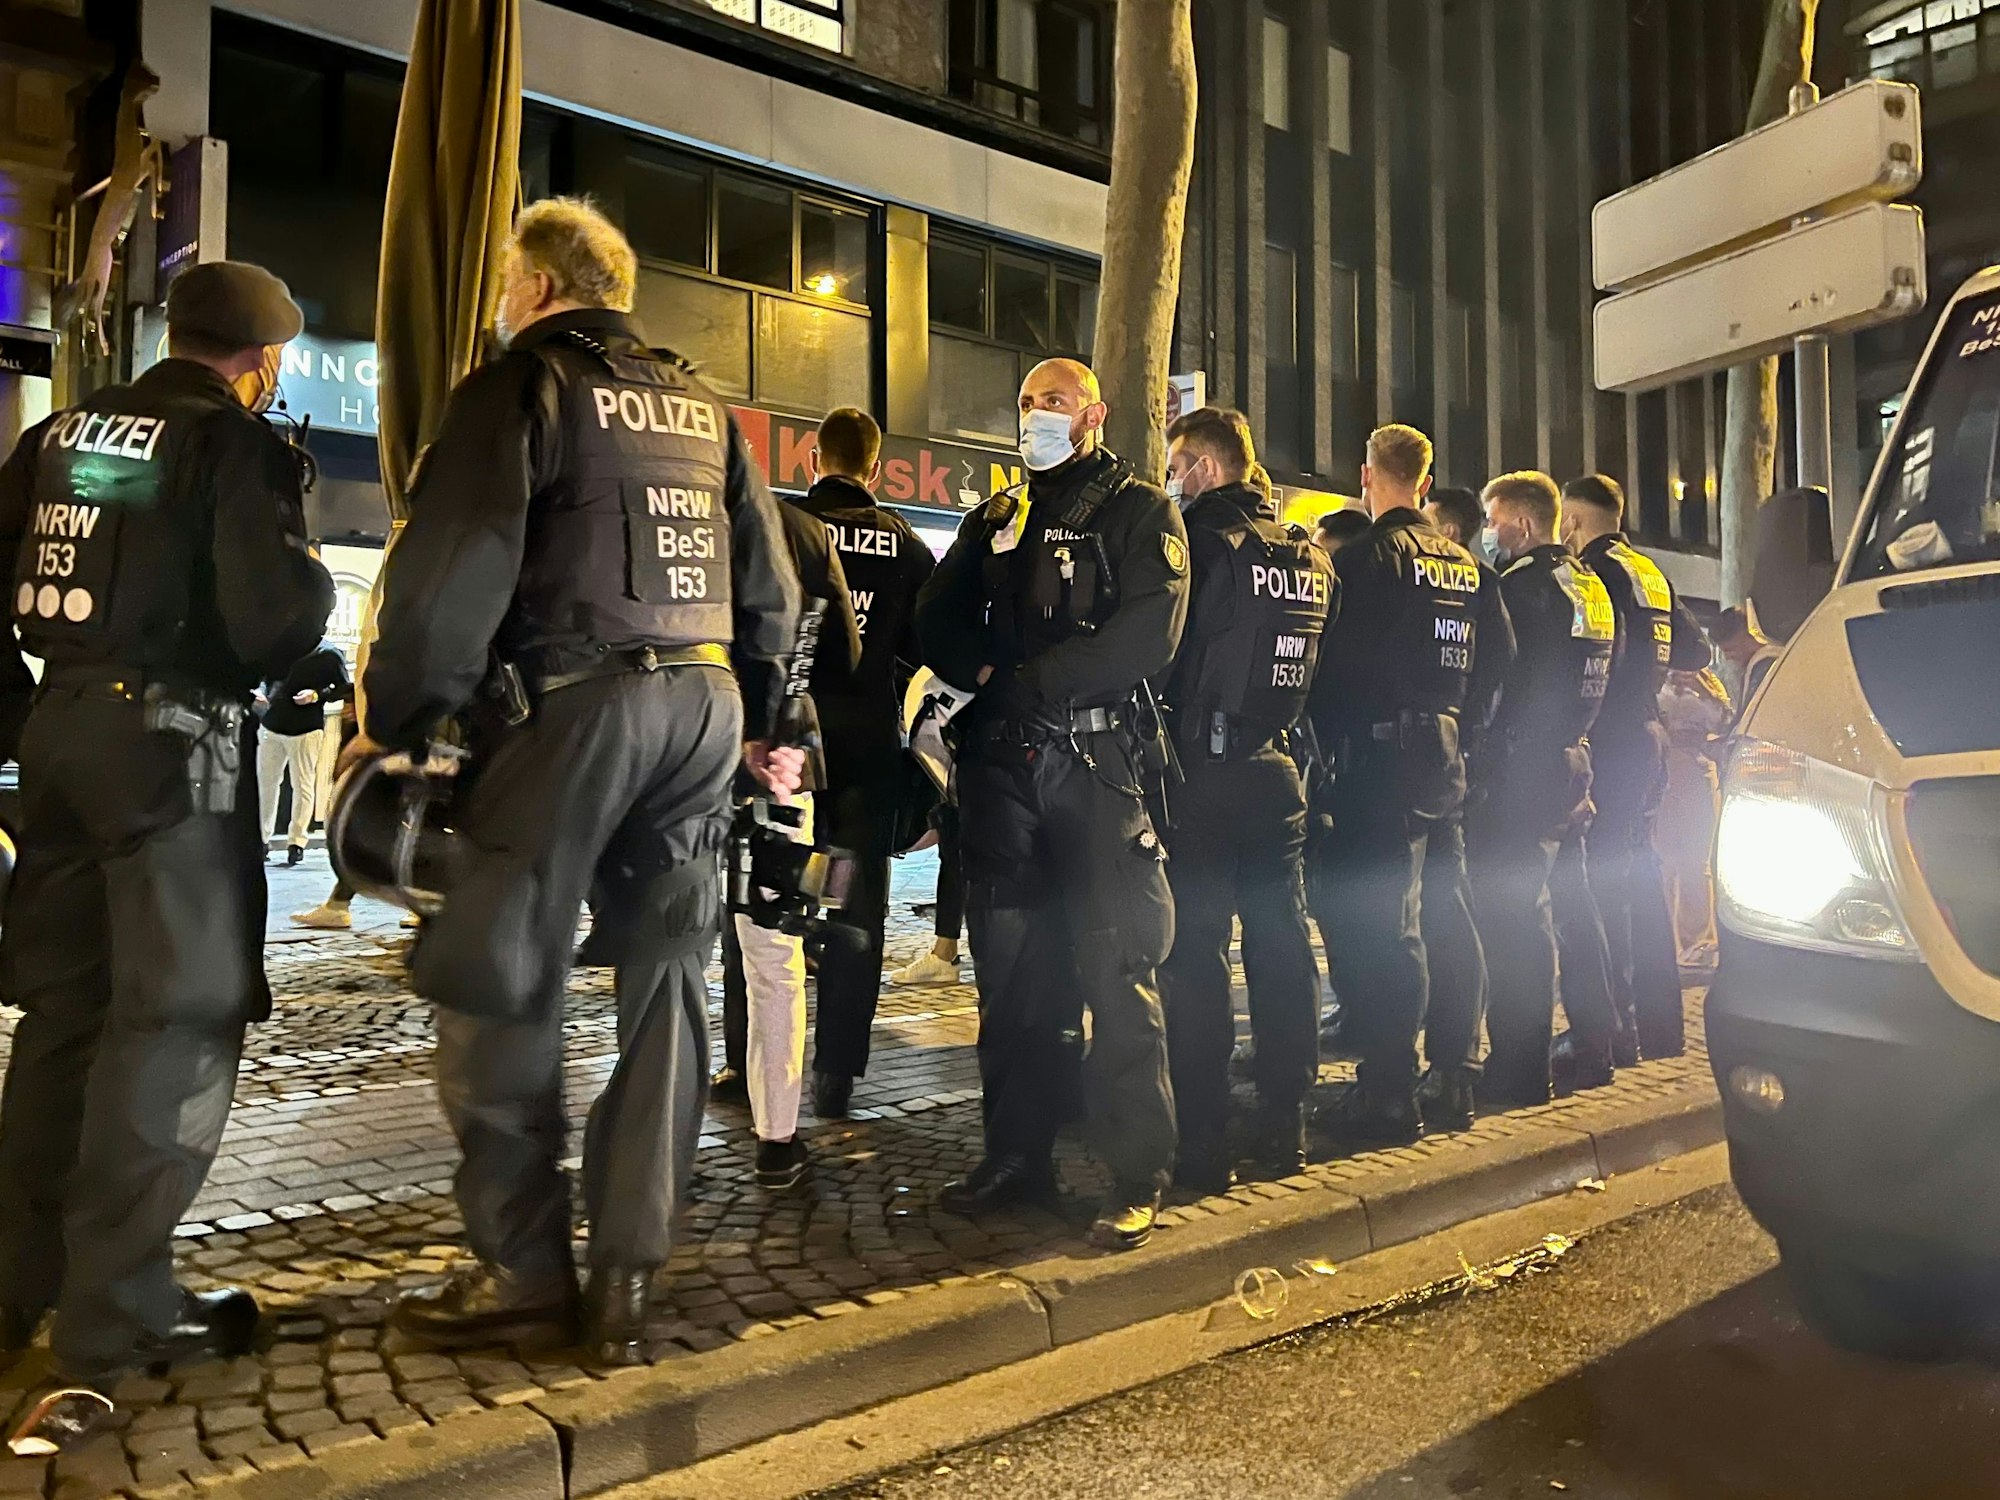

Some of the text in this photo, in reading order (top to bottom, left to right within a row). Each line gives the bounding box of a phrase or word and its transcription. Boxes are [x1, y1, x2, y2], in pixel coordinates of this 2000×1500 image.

[0, 358, 23, 370] ALL
[592, 387, 718, 442] POLIZEI
[43, 411, 166, 461] POLIZEI
[779, 426, 951, 505] Ksk
[646, 486, 711, 520] NRW
[34, 502, 100, 539] NRW
[656, 525, 715, 559] BeSi
[824, 523, 898, 558] OLIZEI
[37, 542, 76, 577] 153
[1412, 558, 1480, 593] POLIZEI
[667, 566, 707, 600] 153
[1251, 564, 1328, 605] POLIZEI
[1274, 635, 1306, 658] NRW
[1434, 617, 1470, 644] NRW
[1271, 663, 1305, 687] 1533
[1440, 646, 1468, 670] 1533
[1583, 657, 1610, 676] NRW
